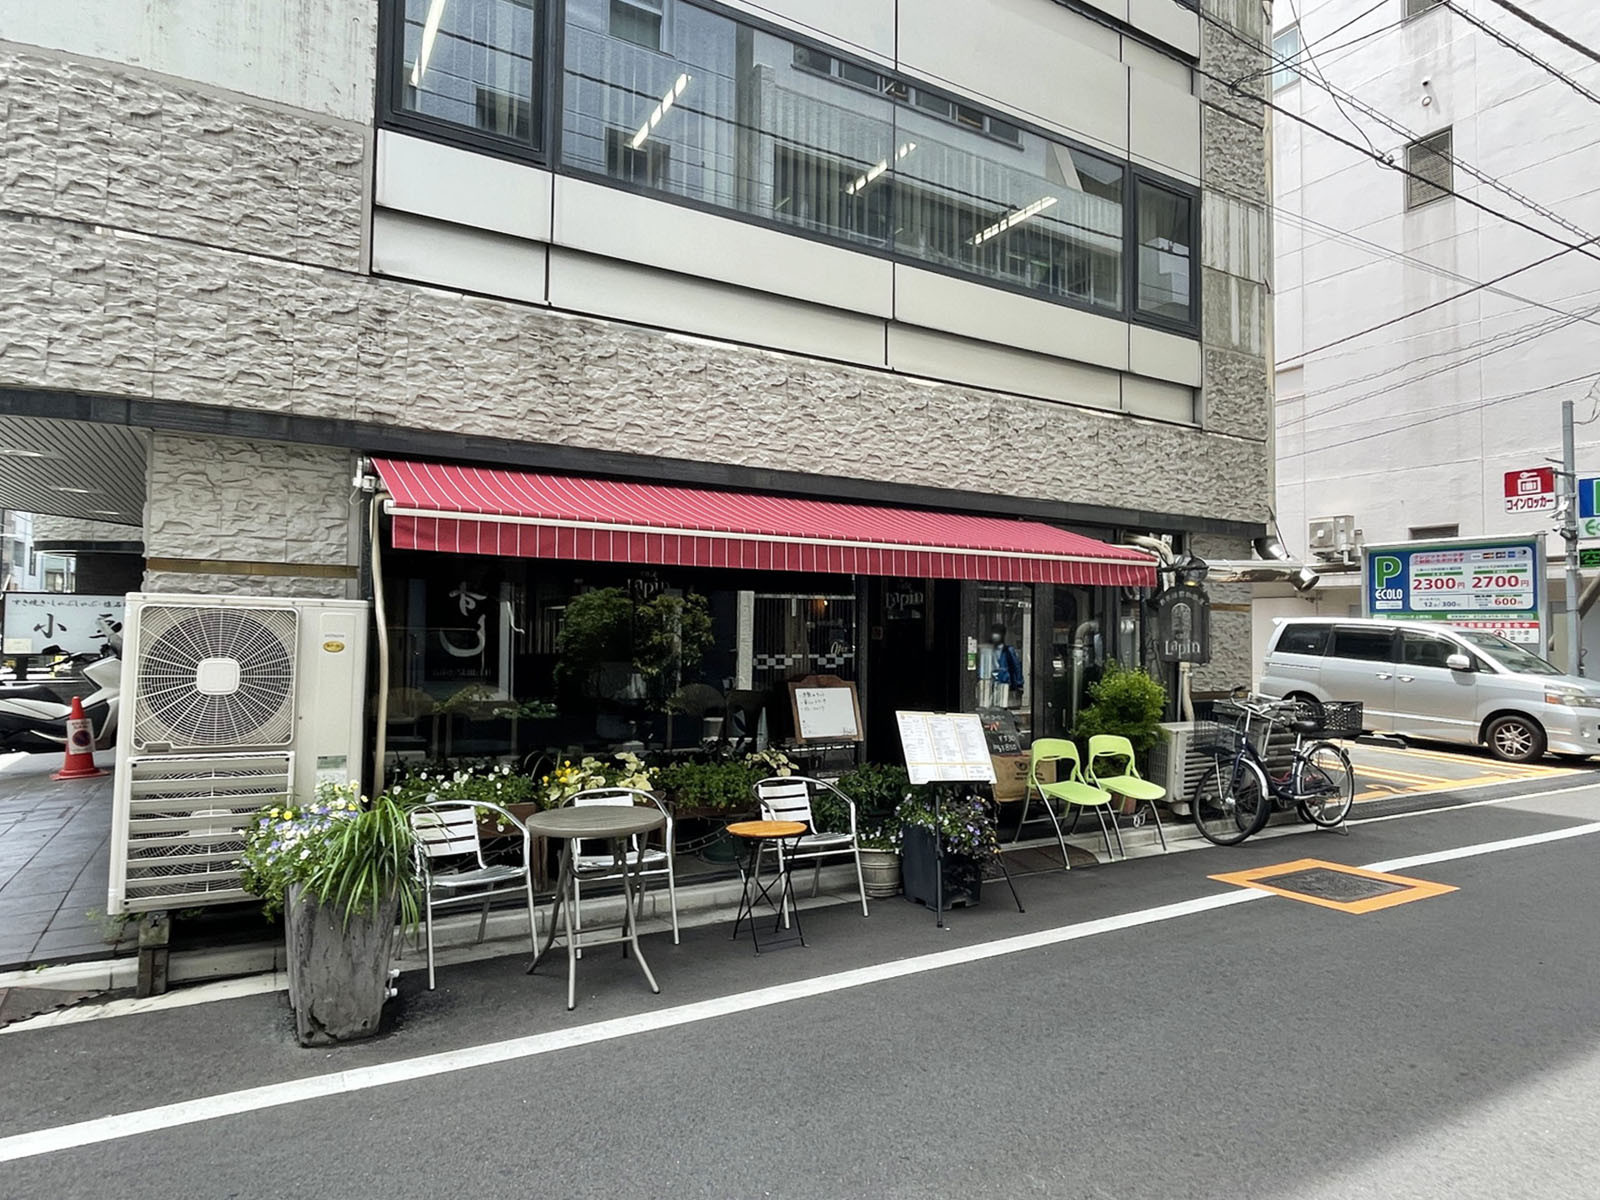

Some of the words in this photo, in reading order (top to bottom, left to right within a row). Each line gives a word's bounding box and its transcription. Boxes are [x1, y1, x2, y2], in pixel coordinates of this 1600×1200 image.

[1506, 495, 1554, 511] コインロッカー
[1375, 555, 1402, 589] P
[1412, 577, 1465, 590] 2300円
[1471, 575, 1530, 589] 2700円
[1375, 588, 1403, 600] ECOLO
[1165, 639, 1201, 659] Lapin
